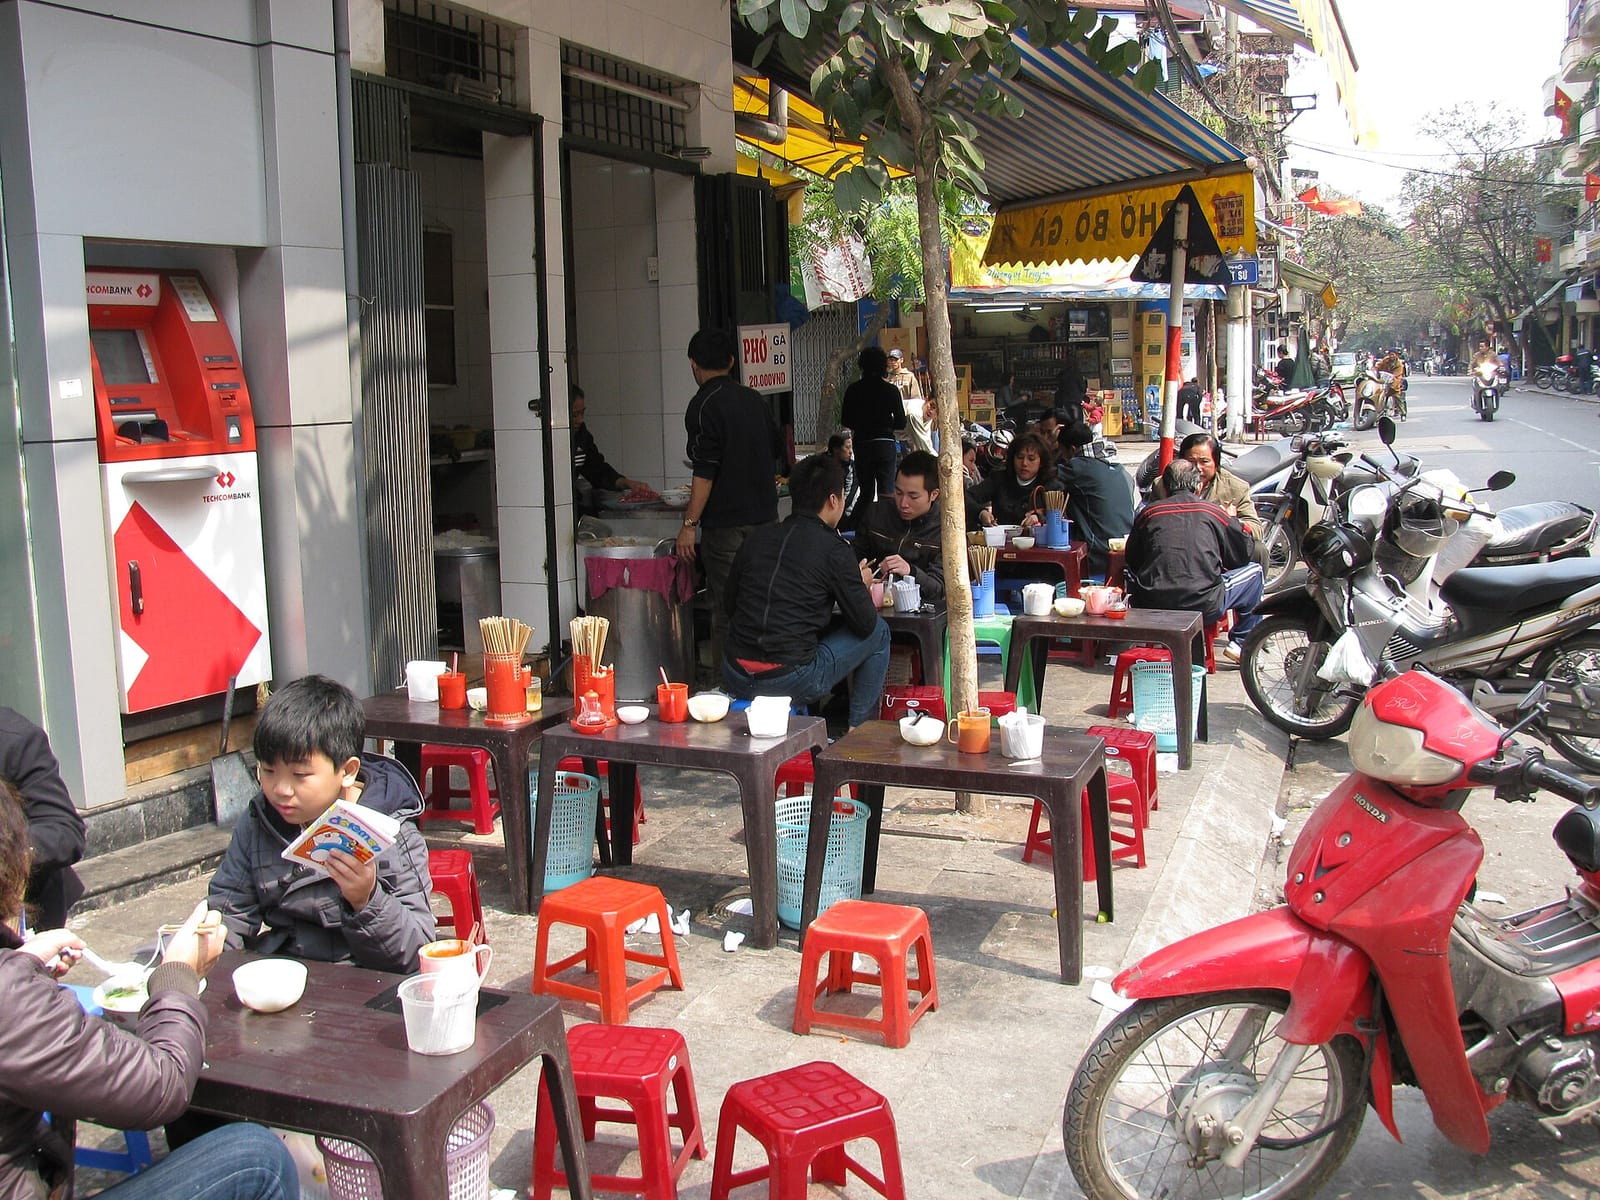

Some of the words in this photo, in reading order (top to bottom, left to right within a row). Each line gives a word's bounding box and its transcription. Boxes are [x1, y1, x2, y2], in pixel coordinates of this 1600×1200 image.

[742, 329, 768, 364] PHỞ
[773, 331, 786, 346] GÀ
[774, 351, 786, 365] BÒ
[202, 491, 251, 503] TECHCOMBANK
[1353, 793, 1386, 823] HONDA
